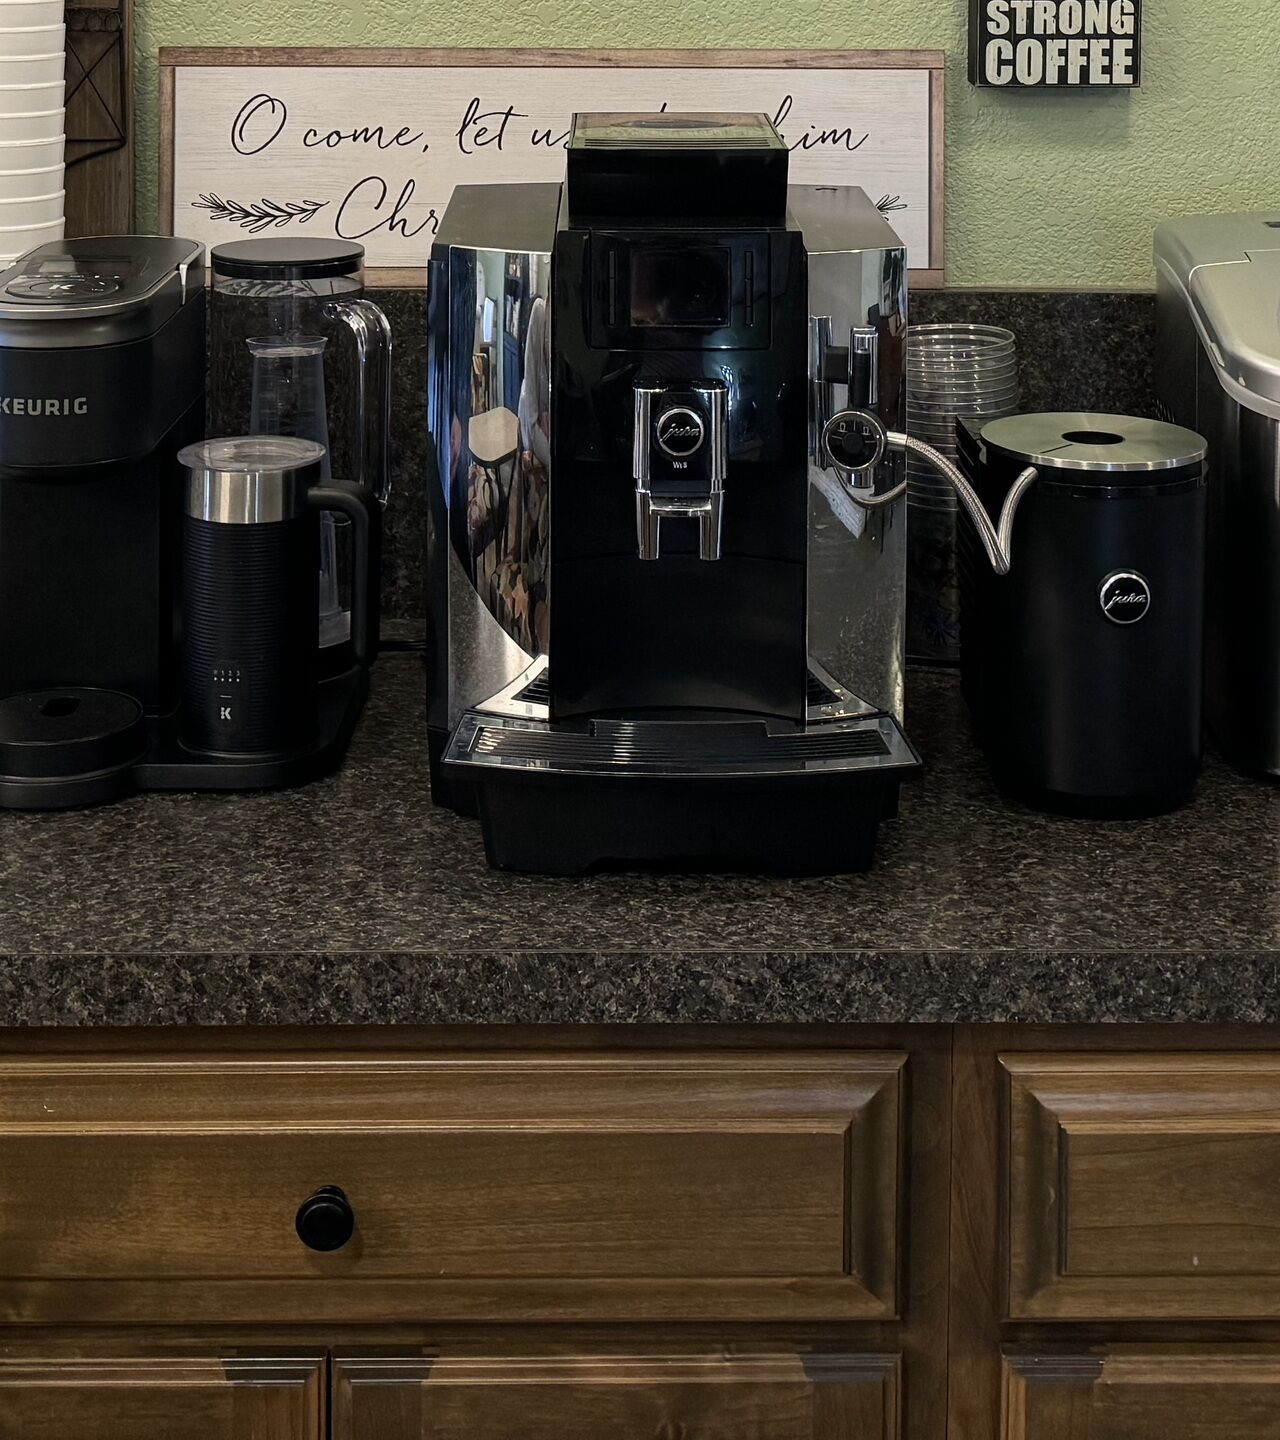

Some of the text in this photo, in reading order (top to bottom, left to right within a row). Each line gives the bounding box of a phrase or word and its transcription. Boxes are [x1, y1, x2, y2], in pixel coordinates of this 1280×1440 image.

[986, 0, 1135, 36] STRONG
[985, 38, 1134, 85] COFFEE
[230, 93, 287, 157] O
[303, 121, 429, 156] come,
[456, 97, 529, 156] let
